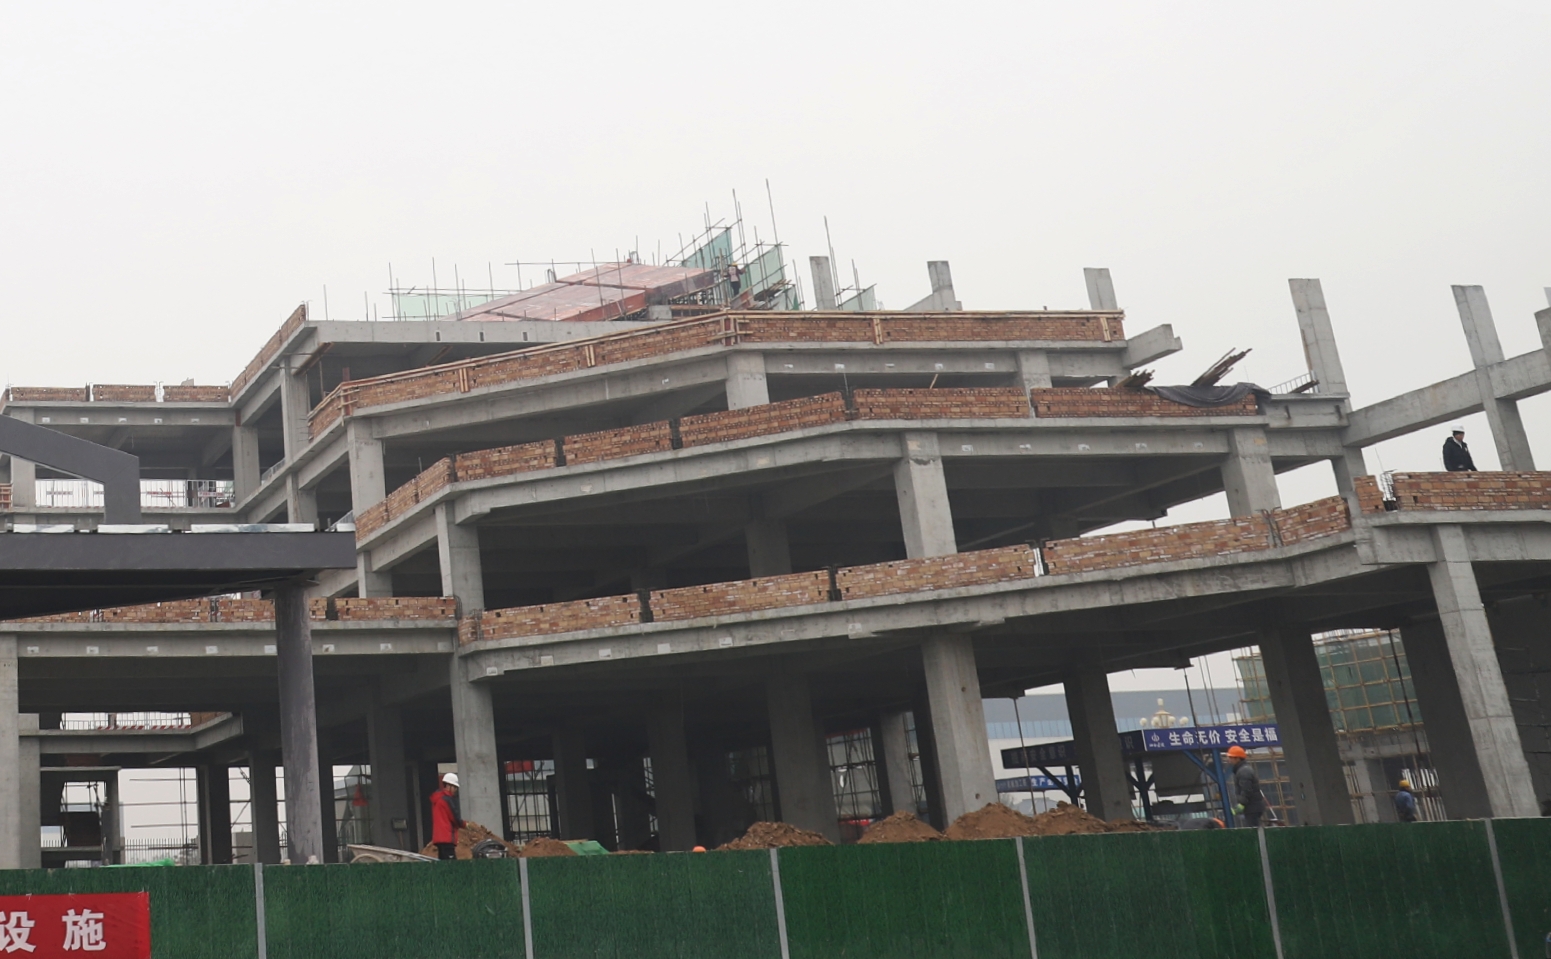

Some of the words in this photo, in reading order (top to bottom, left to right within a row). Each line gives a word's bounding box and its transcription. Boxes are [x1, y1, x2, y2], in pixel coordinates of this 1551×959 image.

[1169, 730, 1220, 746] 生命无价
[1225, 727, 1278, 743] 安全是福
